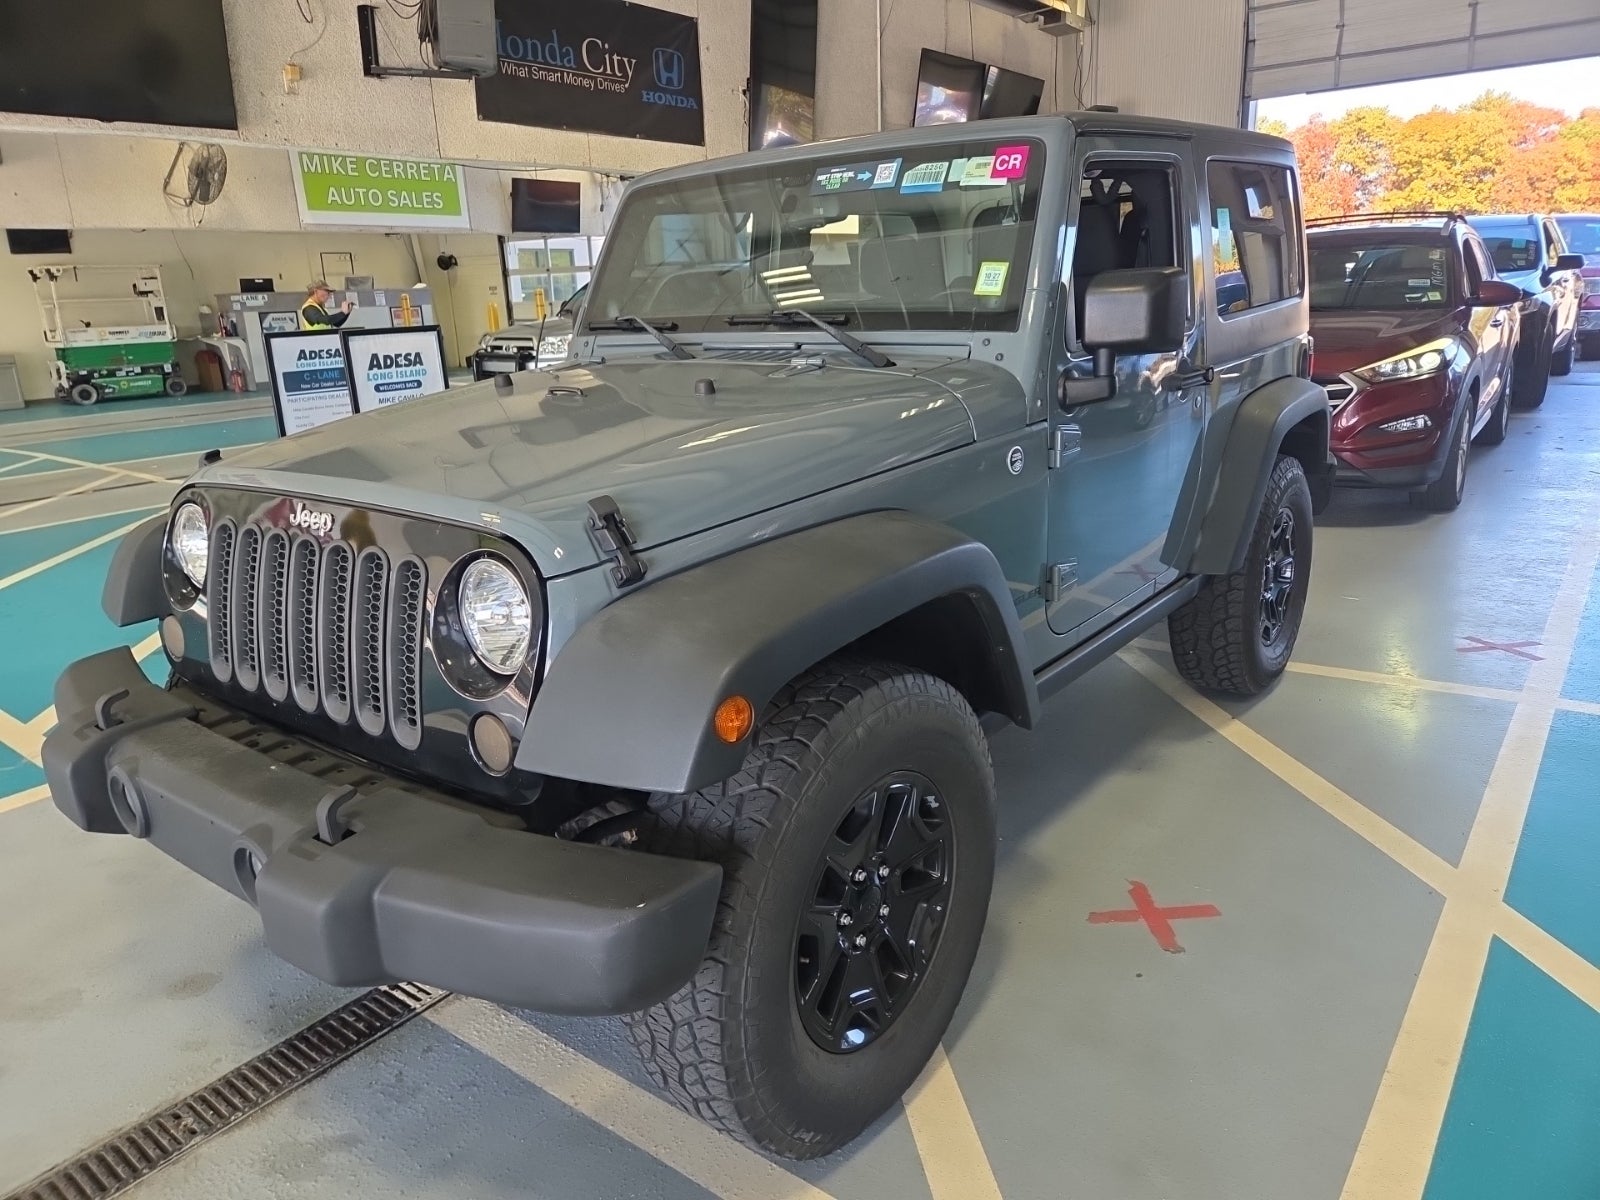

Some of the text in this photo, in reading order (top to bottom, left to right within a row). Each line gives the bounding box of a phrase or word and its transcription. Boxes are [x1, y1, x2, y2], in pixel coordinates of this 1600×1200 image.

[582, 37, 637, 89] City
[500, 61, 626, 93] What Smart Money Drives
[642, 89, 698, 110] HONDA
[302, 153, 456, 183] MIKE CERRETA
[995, 154, 1023, 171] CR
[327, 186, 444, 209] AUTO SALES
[297, 348, 342, 361] ADESA
[368, 351, 424, 371] ADESA
[296, 361, 317, 369] LONG
[303, 371, 311, 381] C
[317, 369, 340, 379] LANE
[367, 368, 428, 382] LONG ISLAND
[378, 396, 396, 405] MIKE
[290, 502, 334, 537] Jeep
